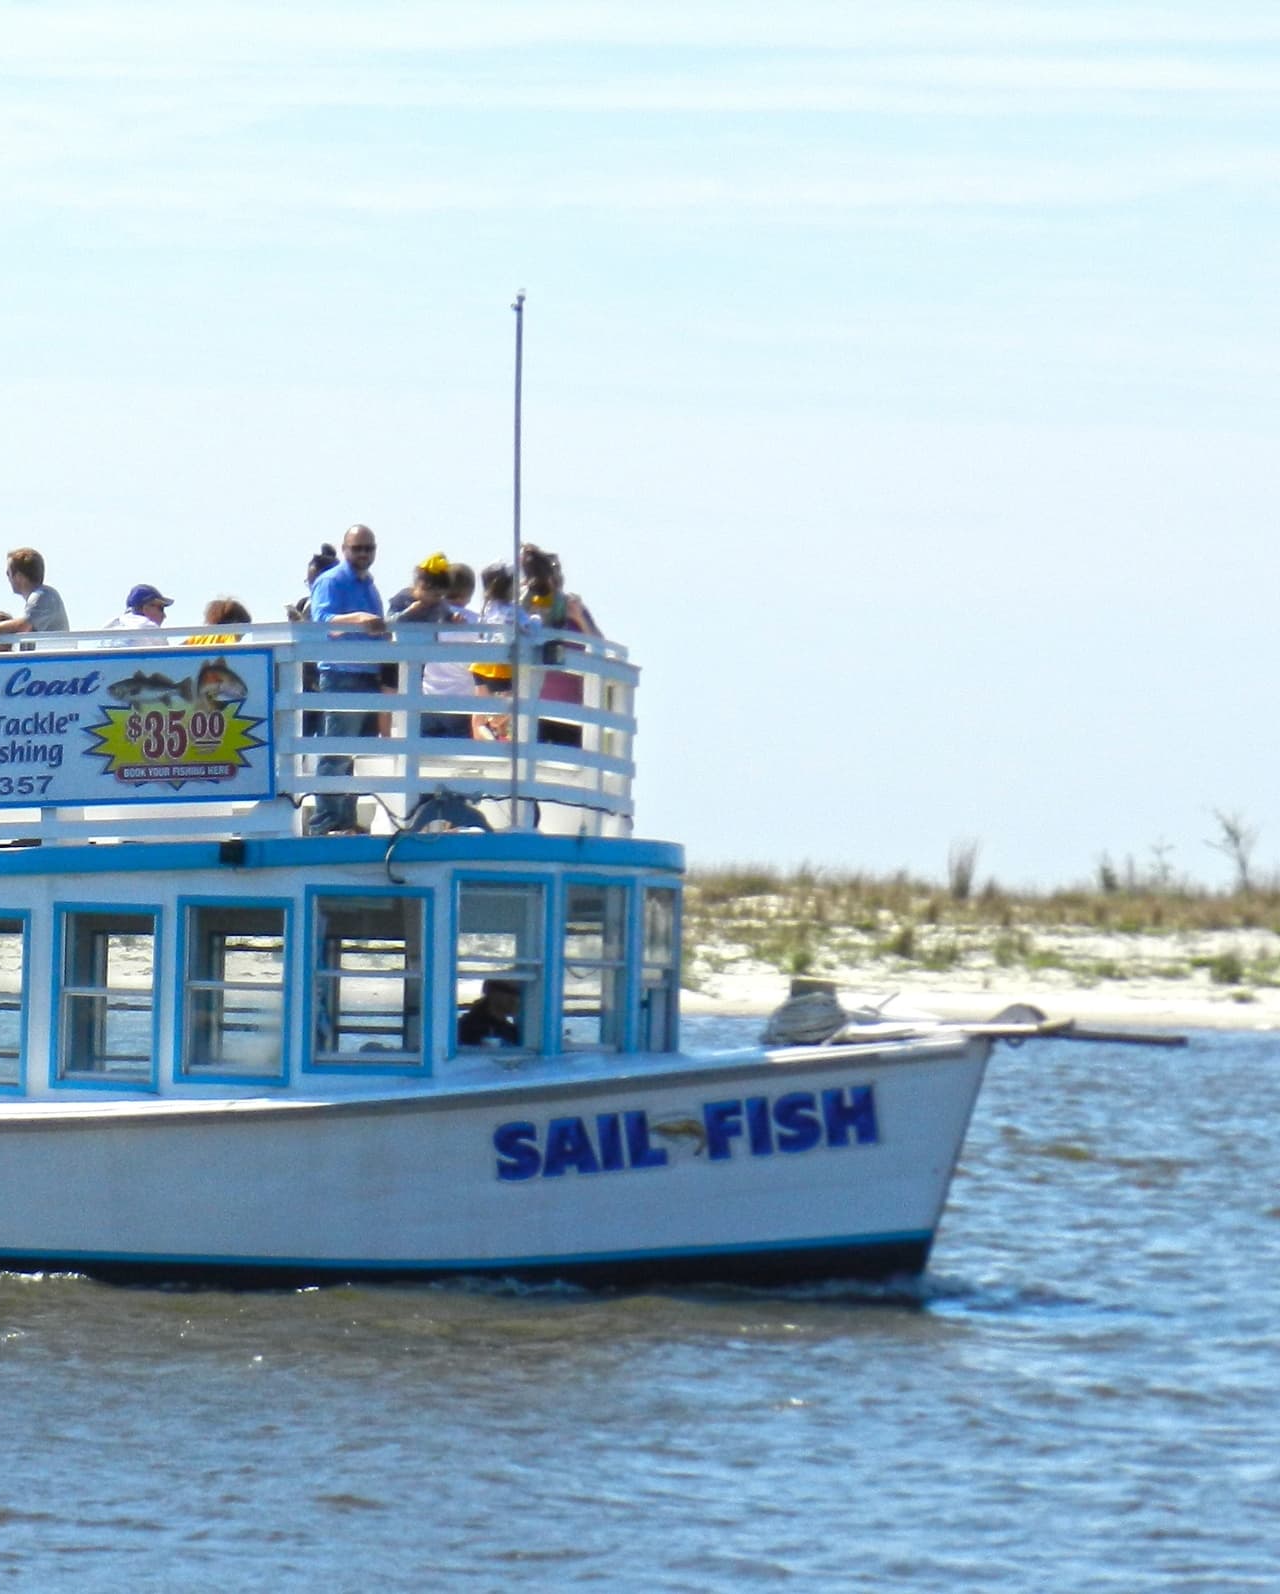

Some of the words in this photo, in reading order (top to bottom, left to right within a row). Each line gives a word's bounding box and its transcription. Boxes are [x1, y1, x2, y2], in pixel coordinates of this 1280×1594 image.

[6, 668, 101, 697] Coast
[124, 766, 146, 778] BOOK
[149, 766, 170, 776] YOUR
[172, 765, 206, 776] FISHING
[208, 764, 230, 775] HERE
[493, 1110, 668, 1181] SAIL
[704, 1083, 879, 1160] FISH
